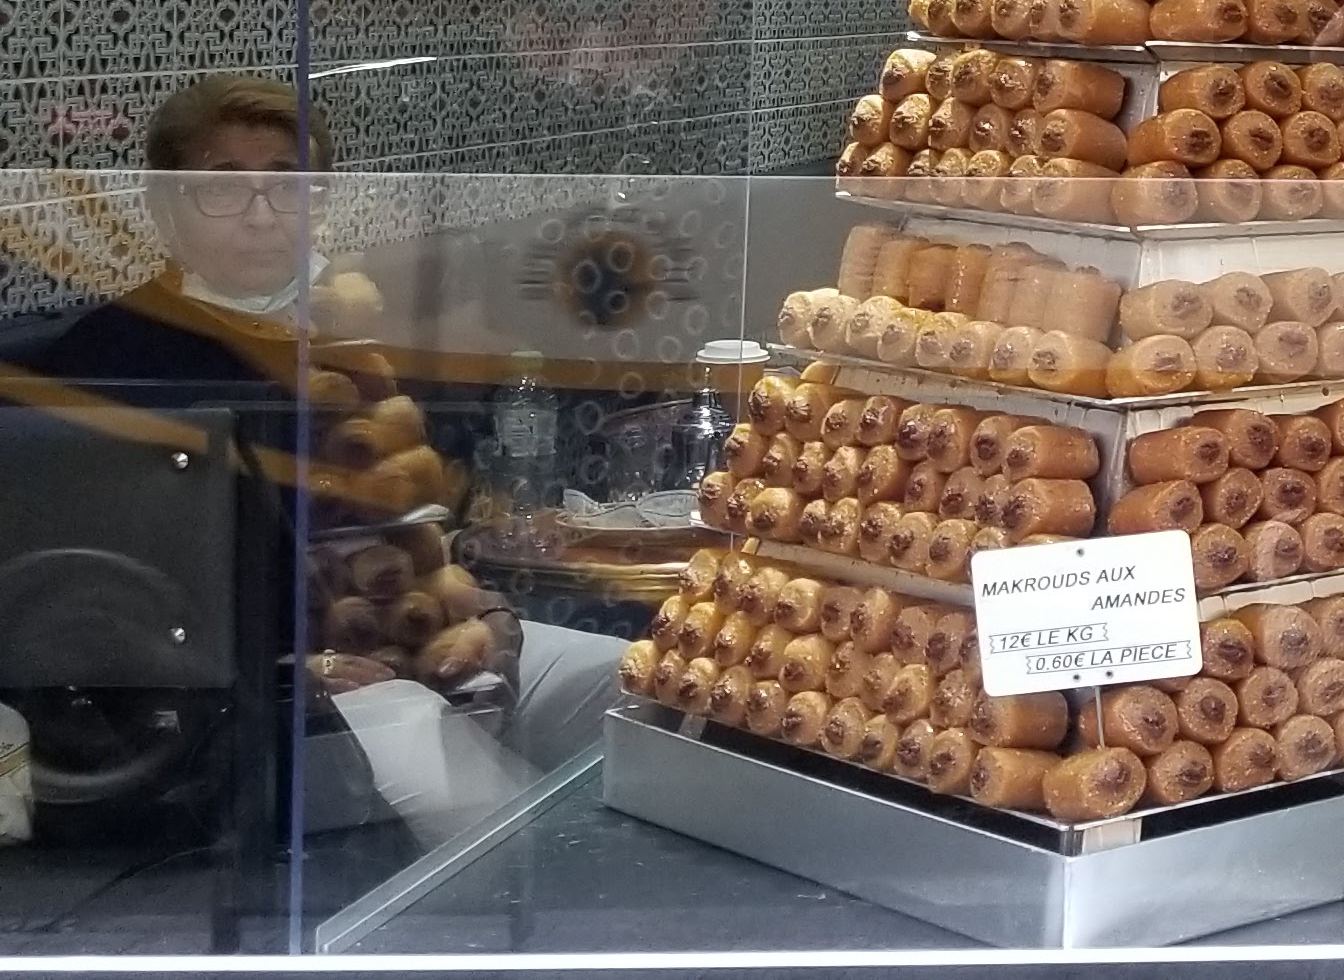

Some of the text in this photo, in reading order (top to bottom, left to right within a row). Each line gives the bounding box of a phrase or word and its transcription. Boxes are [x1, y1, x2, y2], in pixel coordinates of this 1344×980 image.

[981, 565, 1136, 597] MAKROUDS AUX
[1091, 588, 1186, 611] AMANDES
[999, 626, 1094, 651] 12€ LE KG
[1035, 644, 1179, 671] 0.60€ LA PIECE
